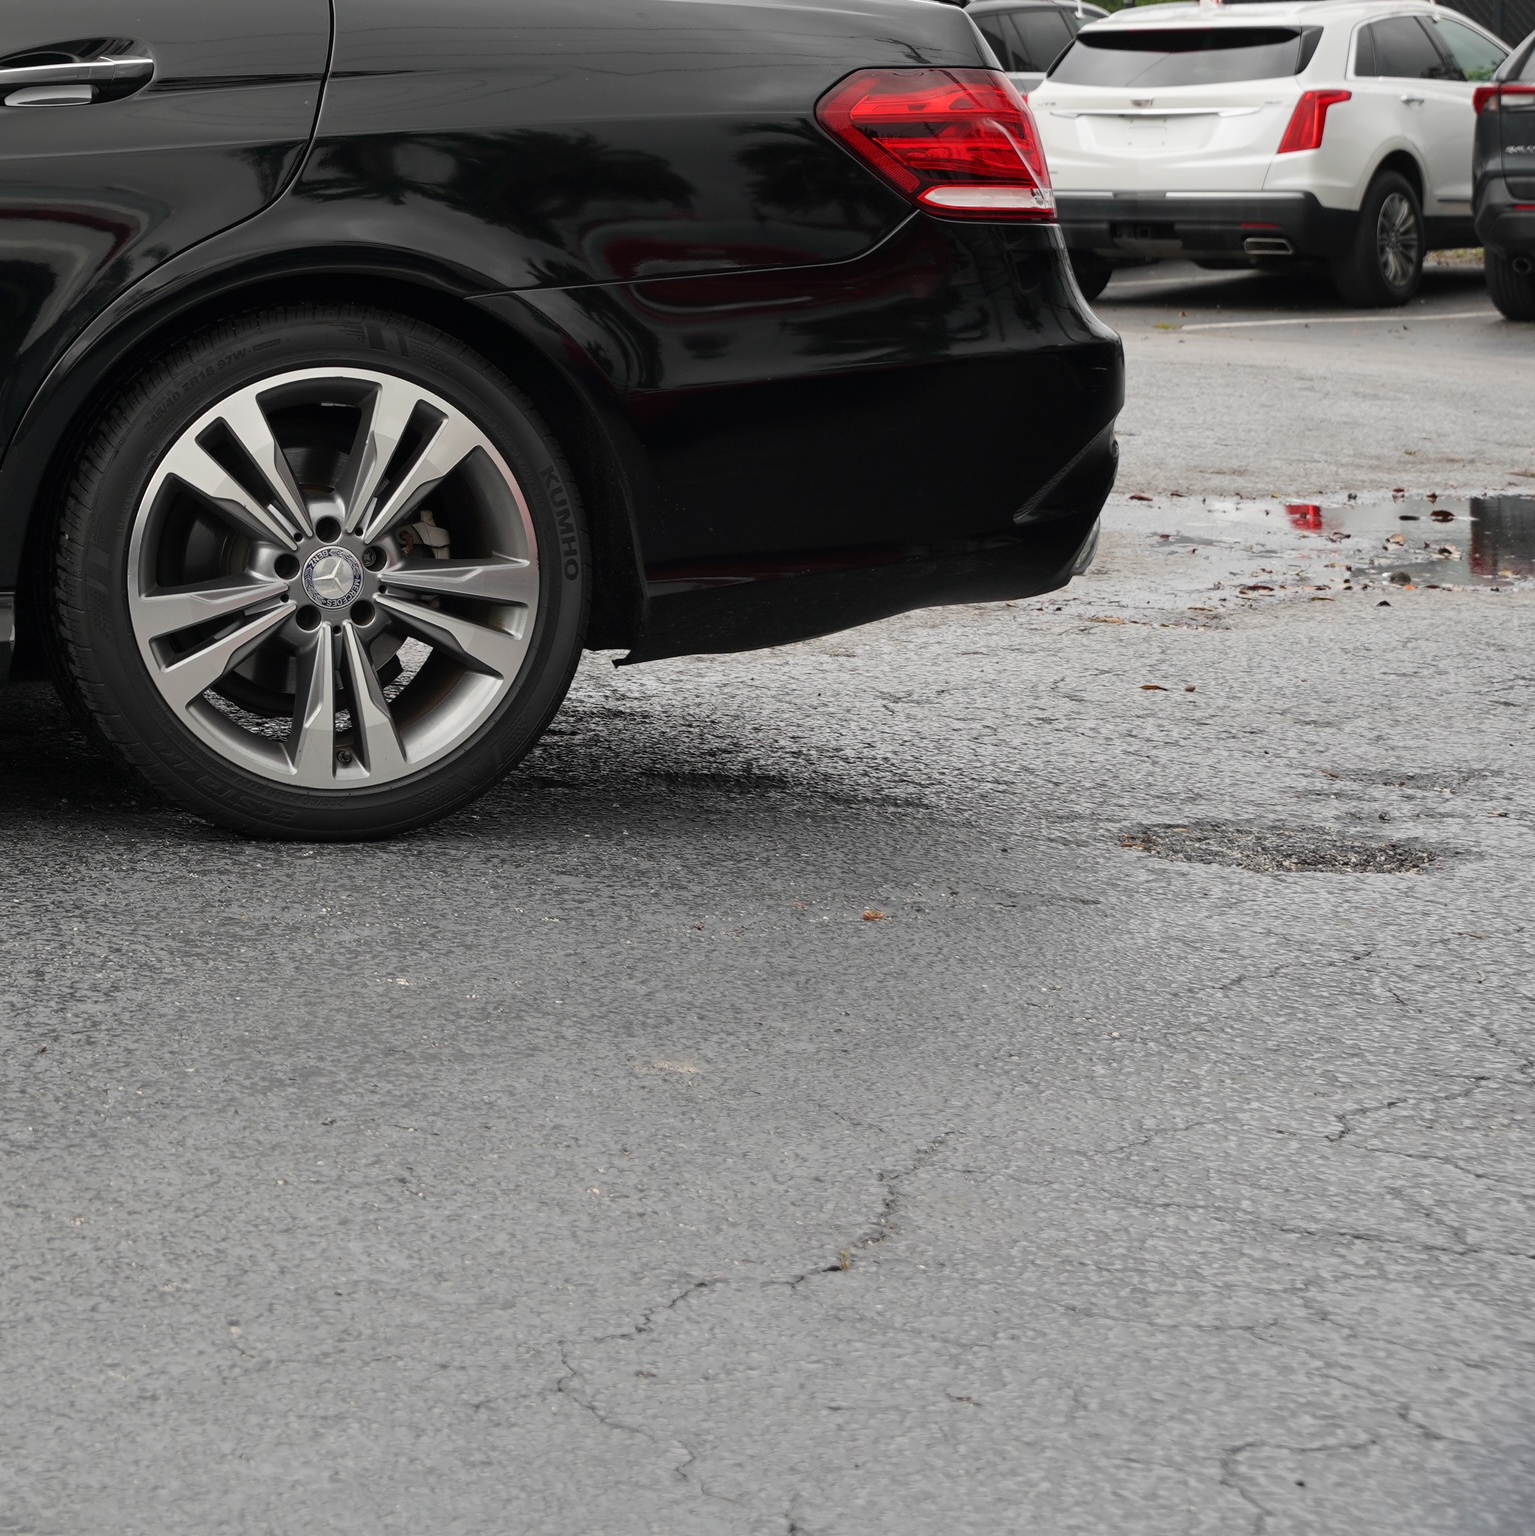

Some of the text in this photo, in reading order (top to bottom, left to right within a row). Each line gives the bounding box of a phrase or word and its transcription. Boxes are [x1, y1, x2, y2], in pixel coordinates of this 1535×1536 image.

[537, 462, 581, 581] KUMHO
[309, 549, 329, 567] BENZ
[327, 578, 361, 606] MERCEDES
